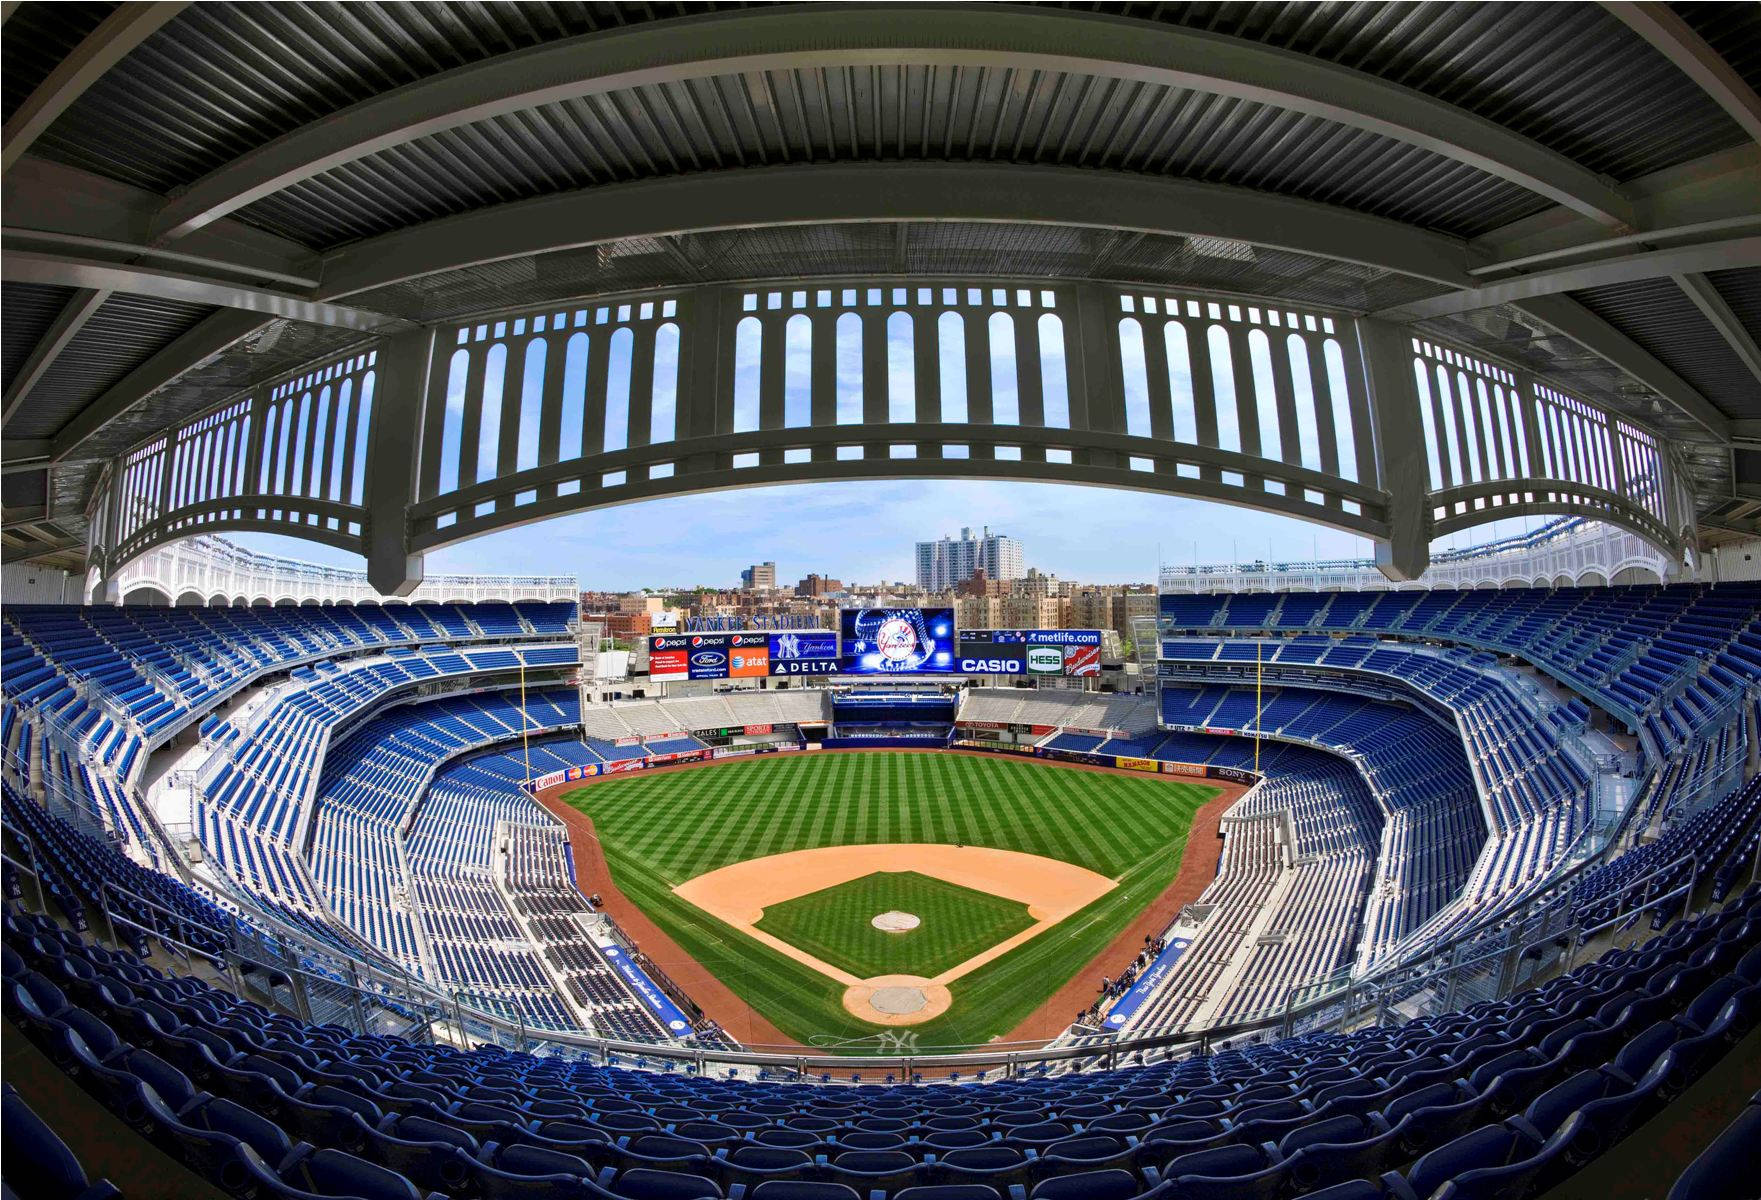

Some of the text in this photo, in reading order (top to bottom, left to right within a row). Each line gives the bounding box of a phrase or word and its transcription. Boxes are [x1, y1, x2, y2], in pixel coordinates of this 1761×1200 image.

[686, 614, 819, 632] YANKEE STADIUM
[666, 638, 687, 647] pepsi
[703, 637, 725, 646] pepsi
[743, 636, 765, 645] pepsi
[1038, 632, 1098, 643] metlife.com
[777, 634, 800, 658] NY
[803, 641, 834, 654] Yankees
[699, 654, 719, 664] Ford
[746, 657, 767, 666] at&t
[1030, 655, 1060, 665] HESS
[790, 662, 838, 672] DELTA
[961, 660, 1020, 672] CASIO
[1218, 769, 1245, 778] SONY
[537, 774, 564, 789] Canon
